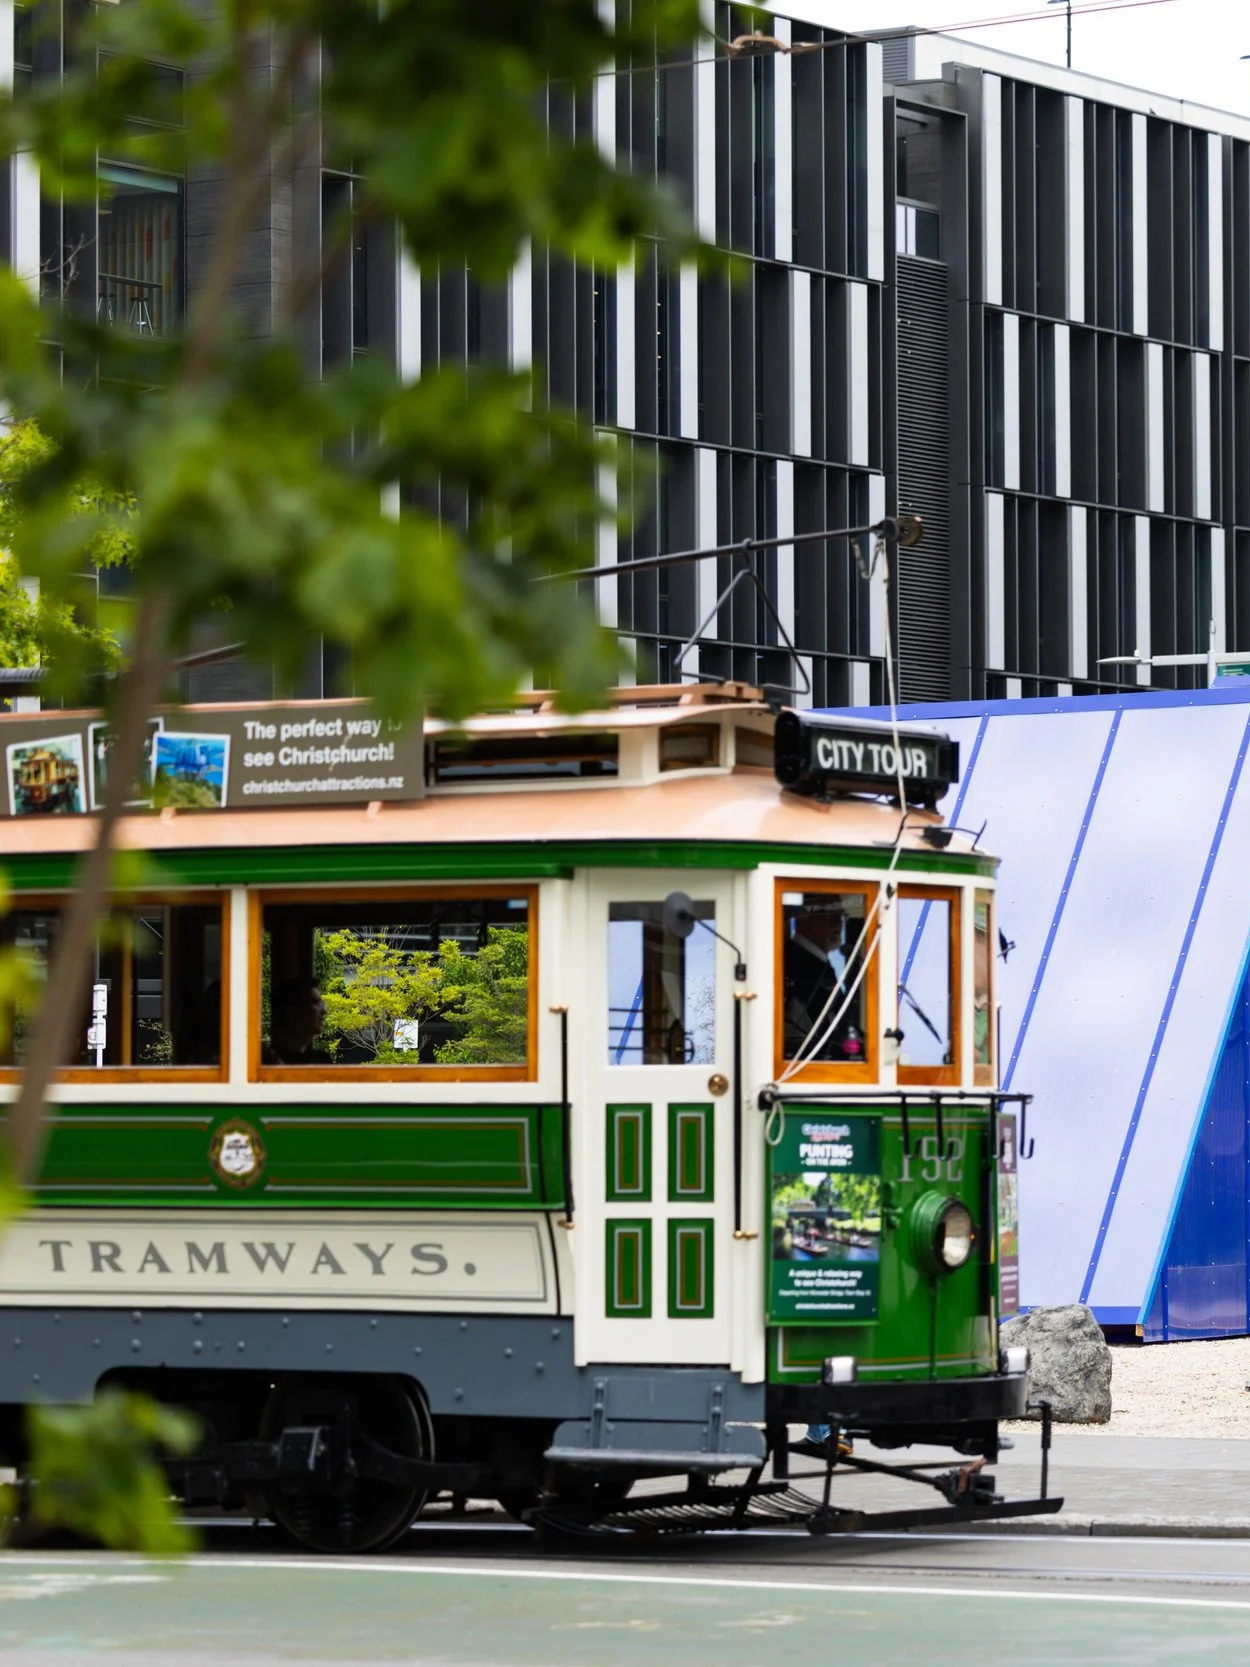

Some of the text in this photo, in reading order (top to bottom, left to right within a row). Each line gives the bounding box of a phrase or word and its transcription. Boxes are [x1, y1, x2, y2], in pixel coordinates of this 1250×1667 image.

[243, 720, 277, 740] The
[280, 718, 343, 742] perfect
[346, 719, 382, 738] way
[243, 742, 395, 767] see Christchurch!
[816, 737, 928, 778] CITY TOUR
[242, 776, 404, 795] christchurchattractions.nz
[799, 1143, 854, 1159] PUNTING
[898, 1136, 964, 1182] 152
[38, 1239, 478, 1276] TRAMWAYS.
